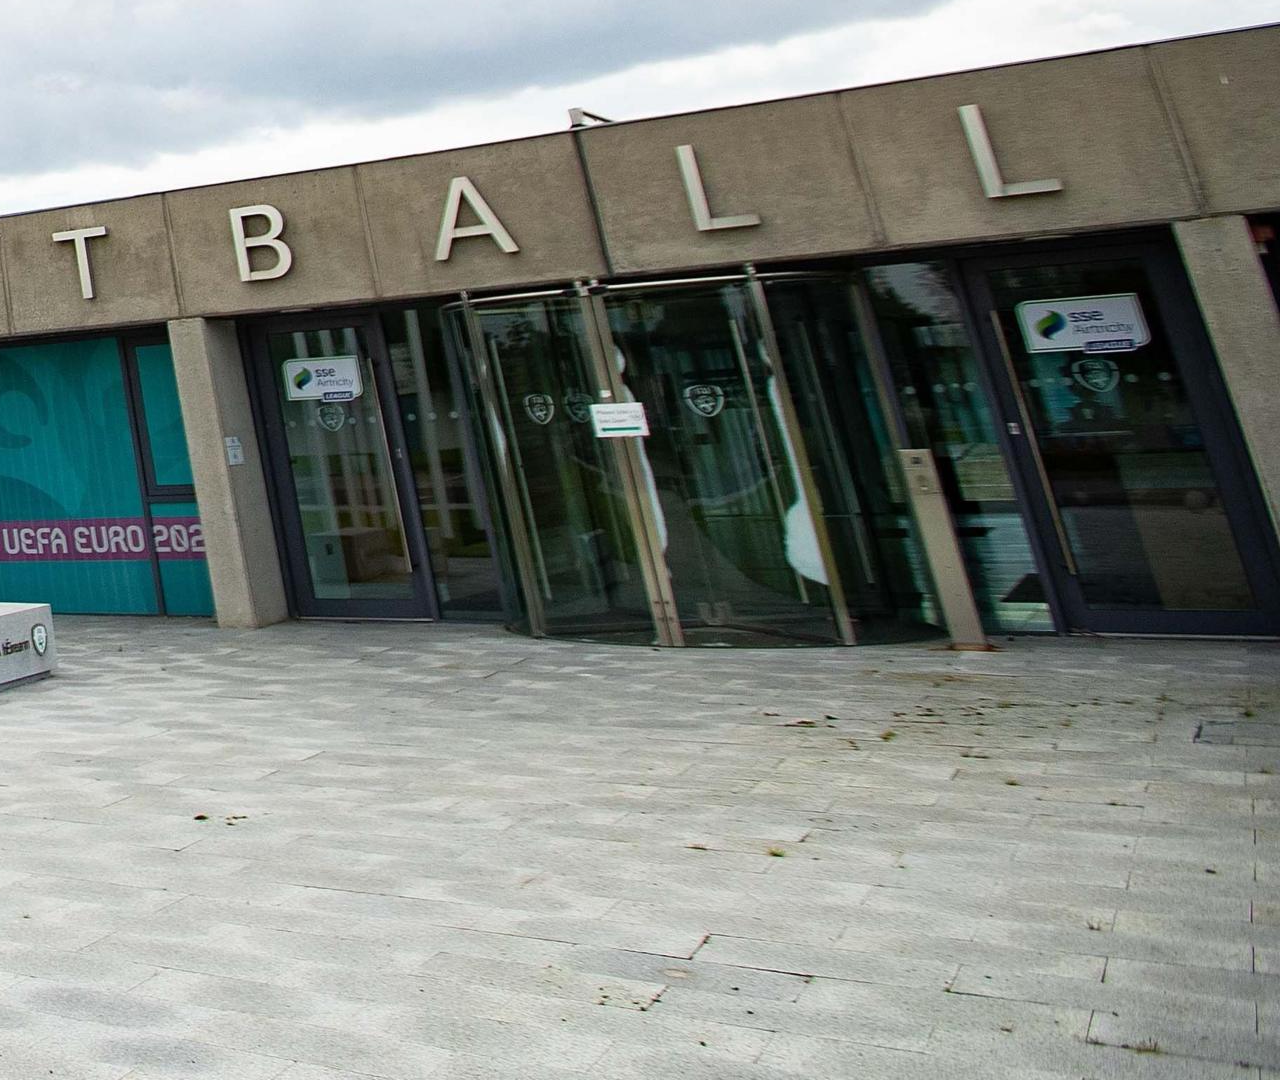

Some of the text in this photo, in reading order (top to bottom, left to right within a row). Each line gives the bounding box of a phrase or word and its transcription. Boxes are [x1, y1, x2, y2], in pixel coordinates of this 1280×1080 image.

[315, 368, 336, 378] sse
[2, 527, 68, 554] UEFA
[73, 525, 145, 553] EURO
